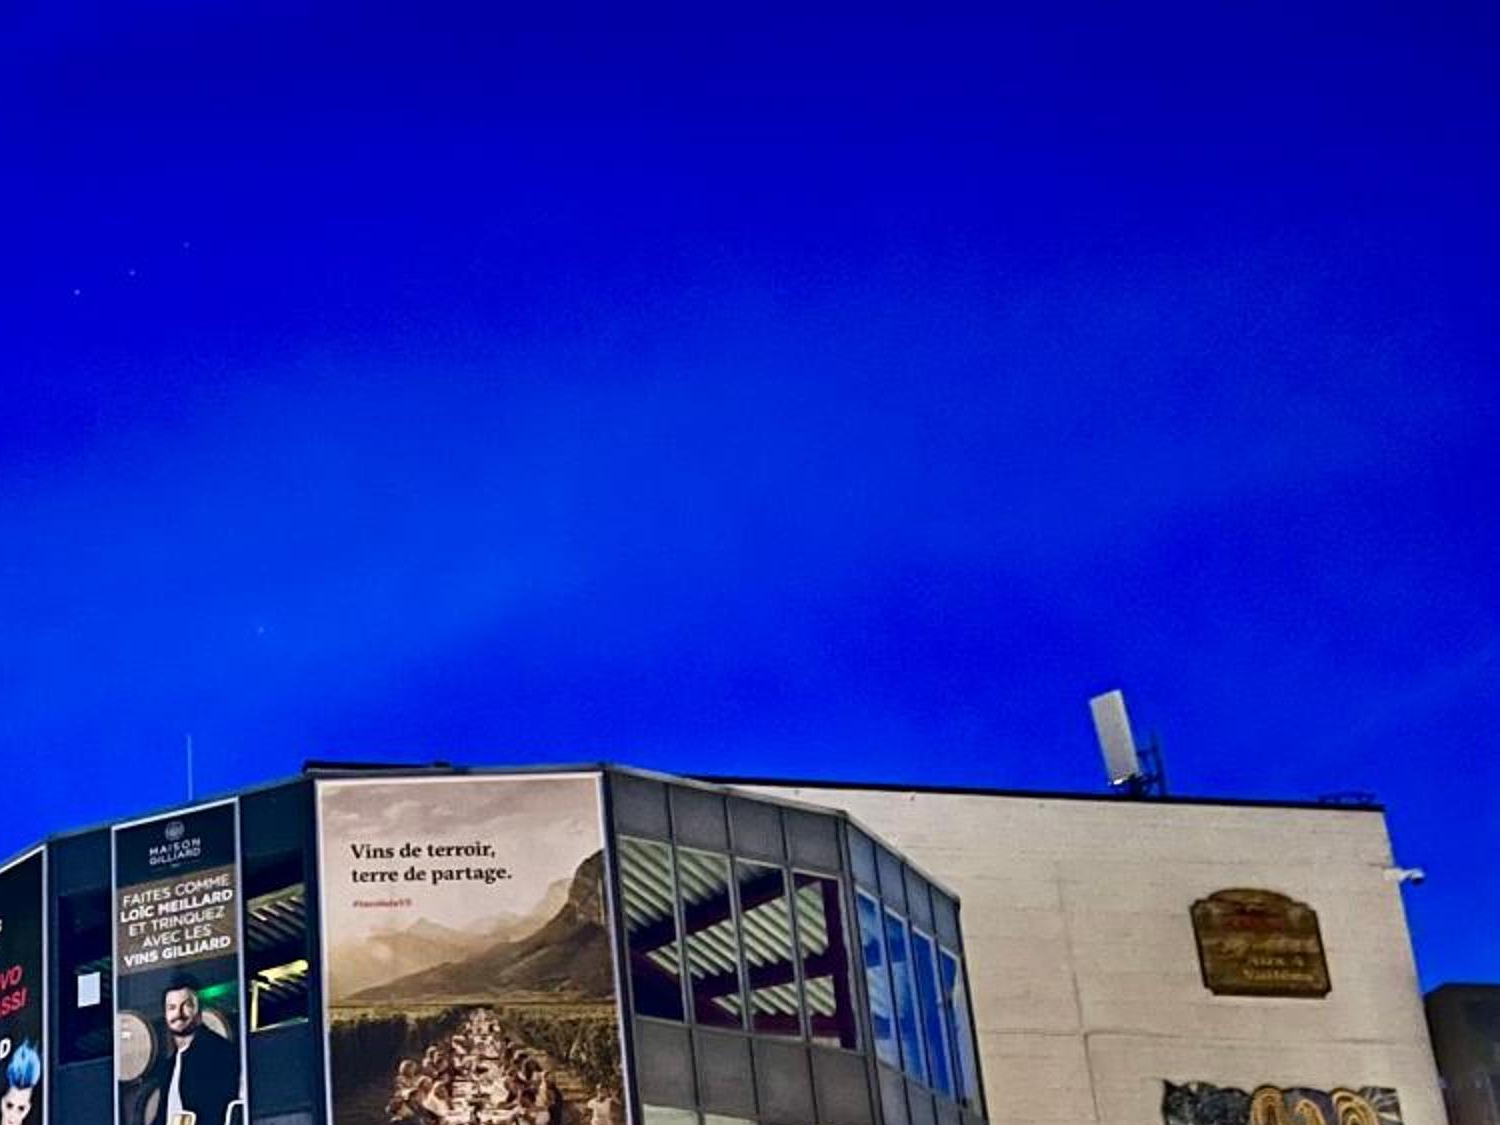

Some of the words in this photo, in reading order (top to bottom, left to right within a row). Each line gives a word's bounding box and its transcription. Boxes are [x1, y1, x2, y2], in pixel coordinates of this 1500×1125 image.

[149, 837, 201, 856] MAISON
[149, 848, 201, 866] GILLIARD
[351, 843, 395, 859] Vins
[399, 842, 422, 858] de
[427, 841, 496, 858] terroir,
[351, 868, 399, 883] terre
[403, 865, 427, 881] de
[431, 865, 512, 886] partage.
[122, 886, 171, 907] FAITES
[174, 873, 230, 896] COMME
[157, 889, 233, 916] MEILLARD
[129, 921, 148, 937] ET
[151, 905, 226, 931] TRINQUEZ
[141, 929, 181, 948] AVEC
[184, 923, 212, 940] LES
[123, 952, 159, 968] VINS
[162, 935, 231, 959] GILLIARD
